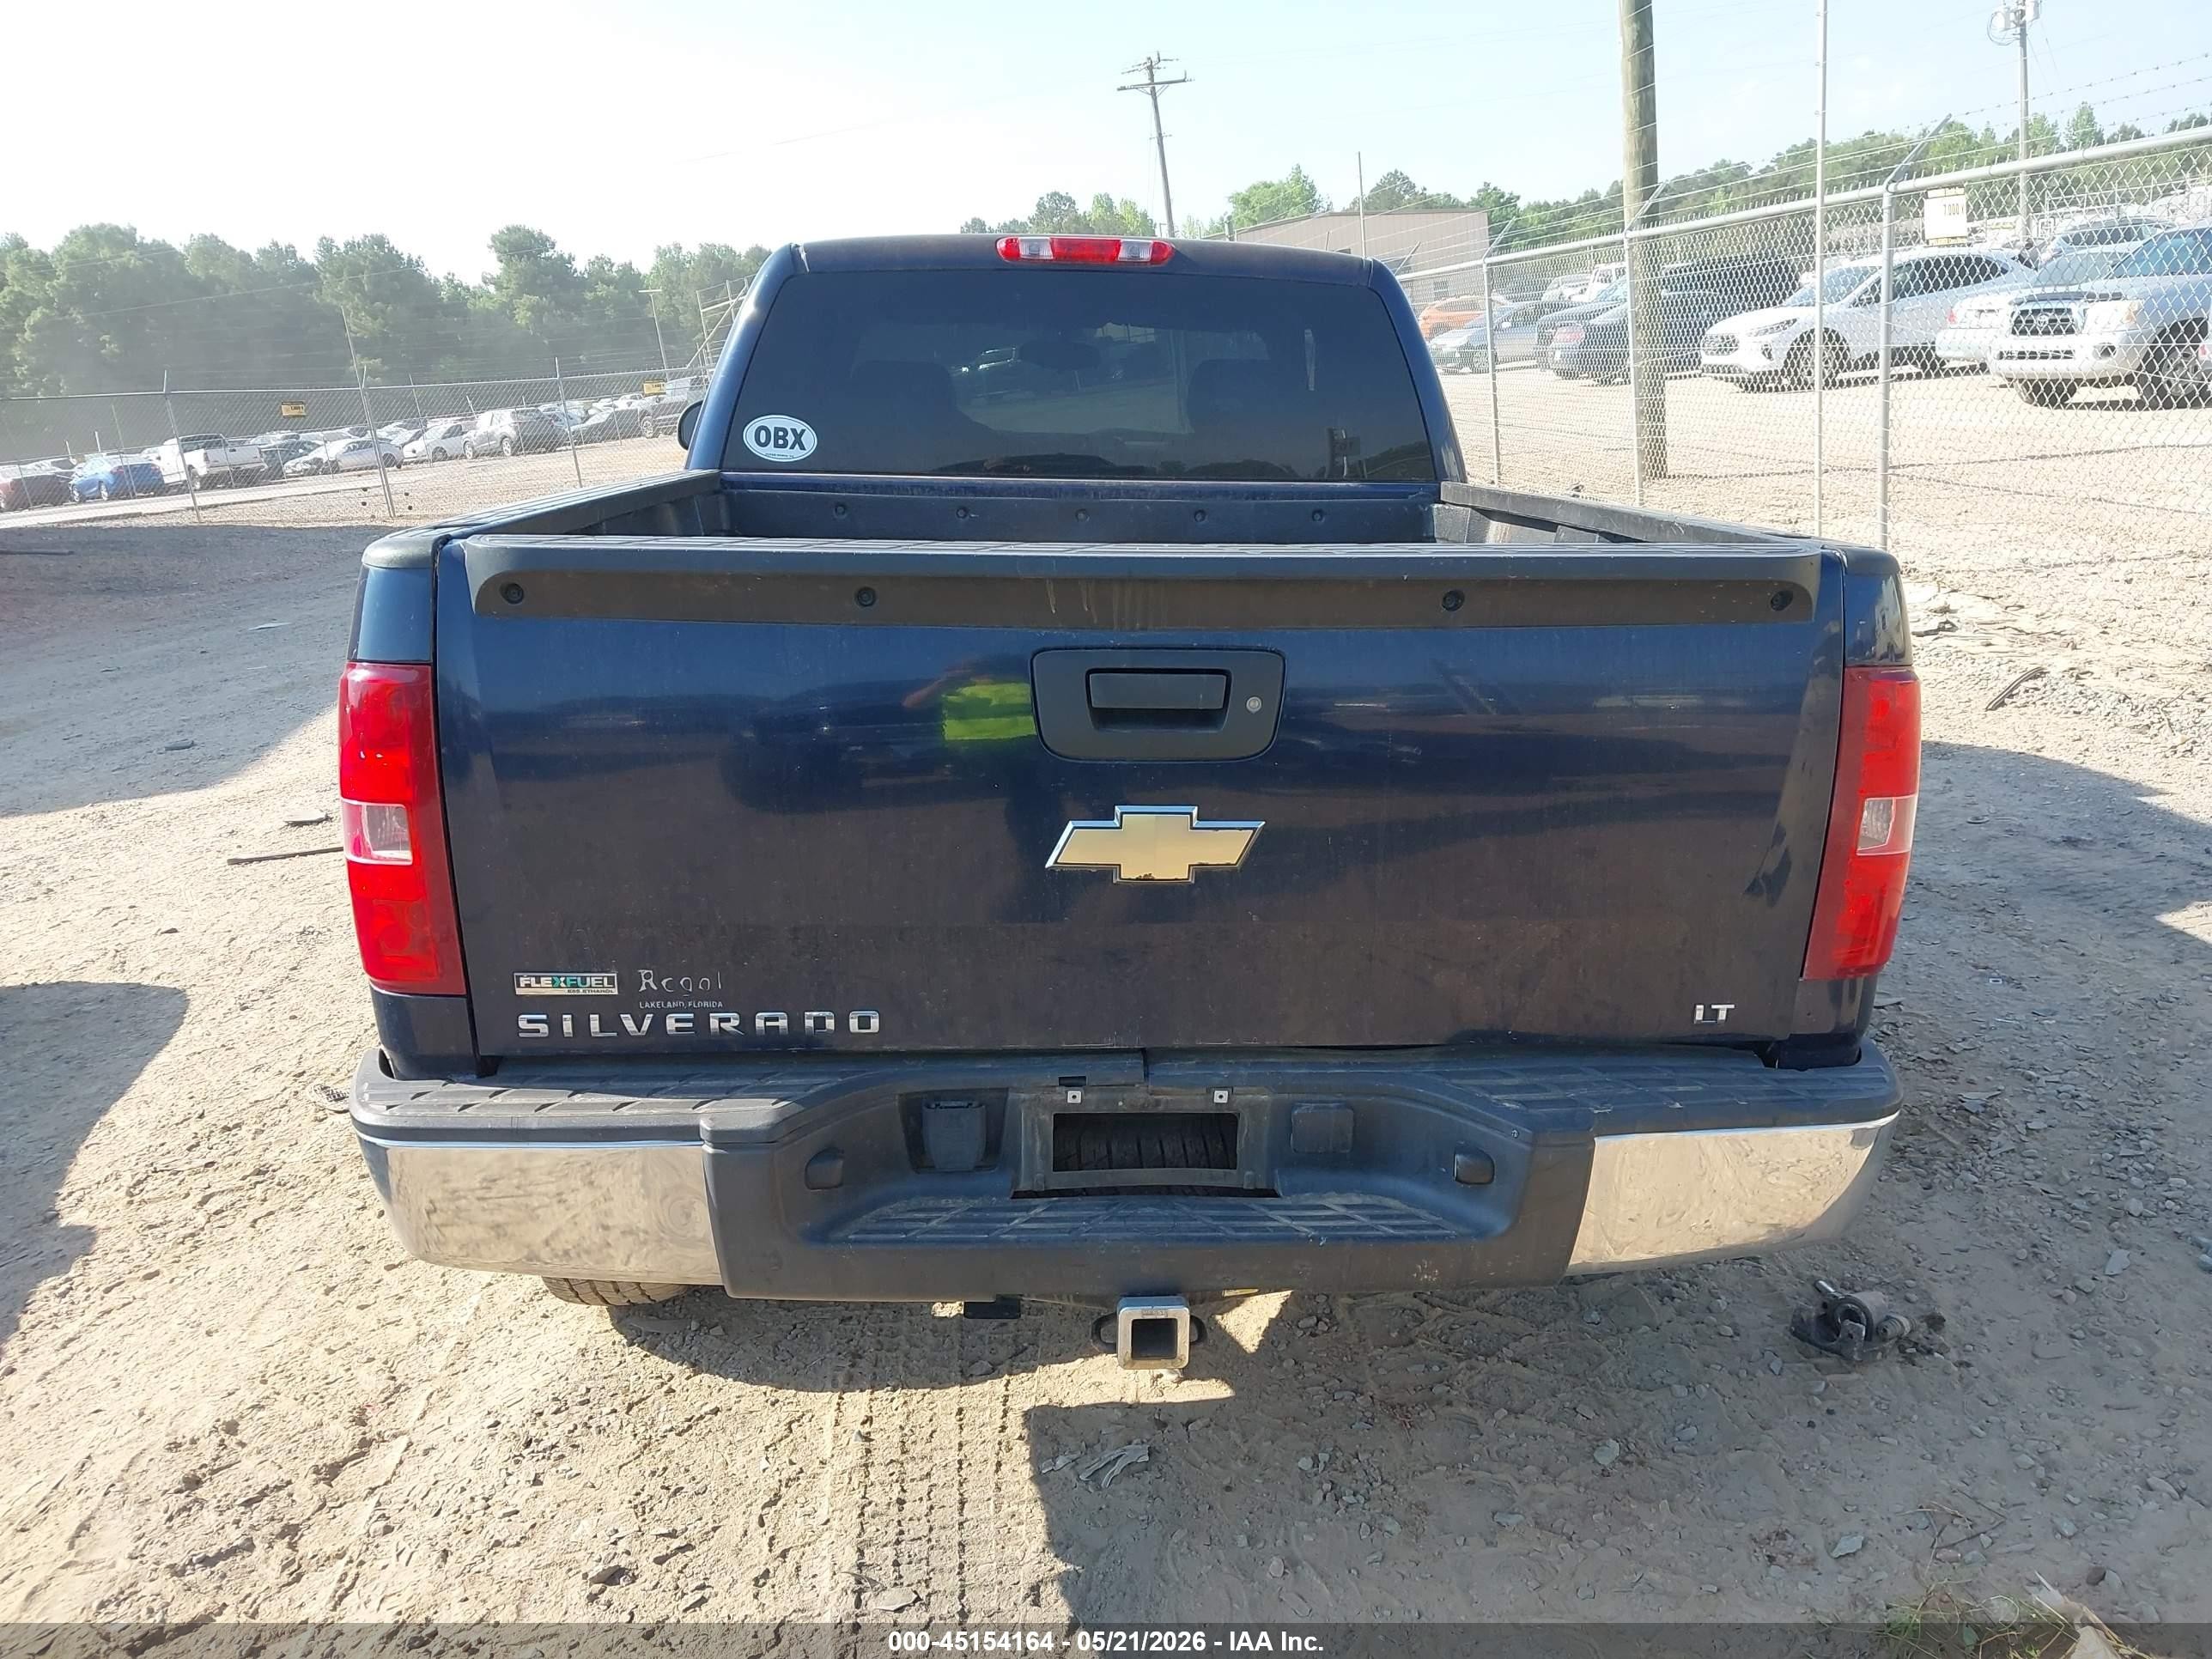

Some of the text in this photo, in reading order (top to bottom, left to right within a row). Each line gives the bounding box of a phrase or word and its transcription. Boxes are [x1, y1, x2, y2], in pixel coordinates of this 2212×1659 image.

[754, 425, 806, 451] OBX
[520, 975, 614, 988] FLEXFUEL
[517, 1010, 880, 1038] SILVERADO
[1694, 1004, 1735, 1024] LT
